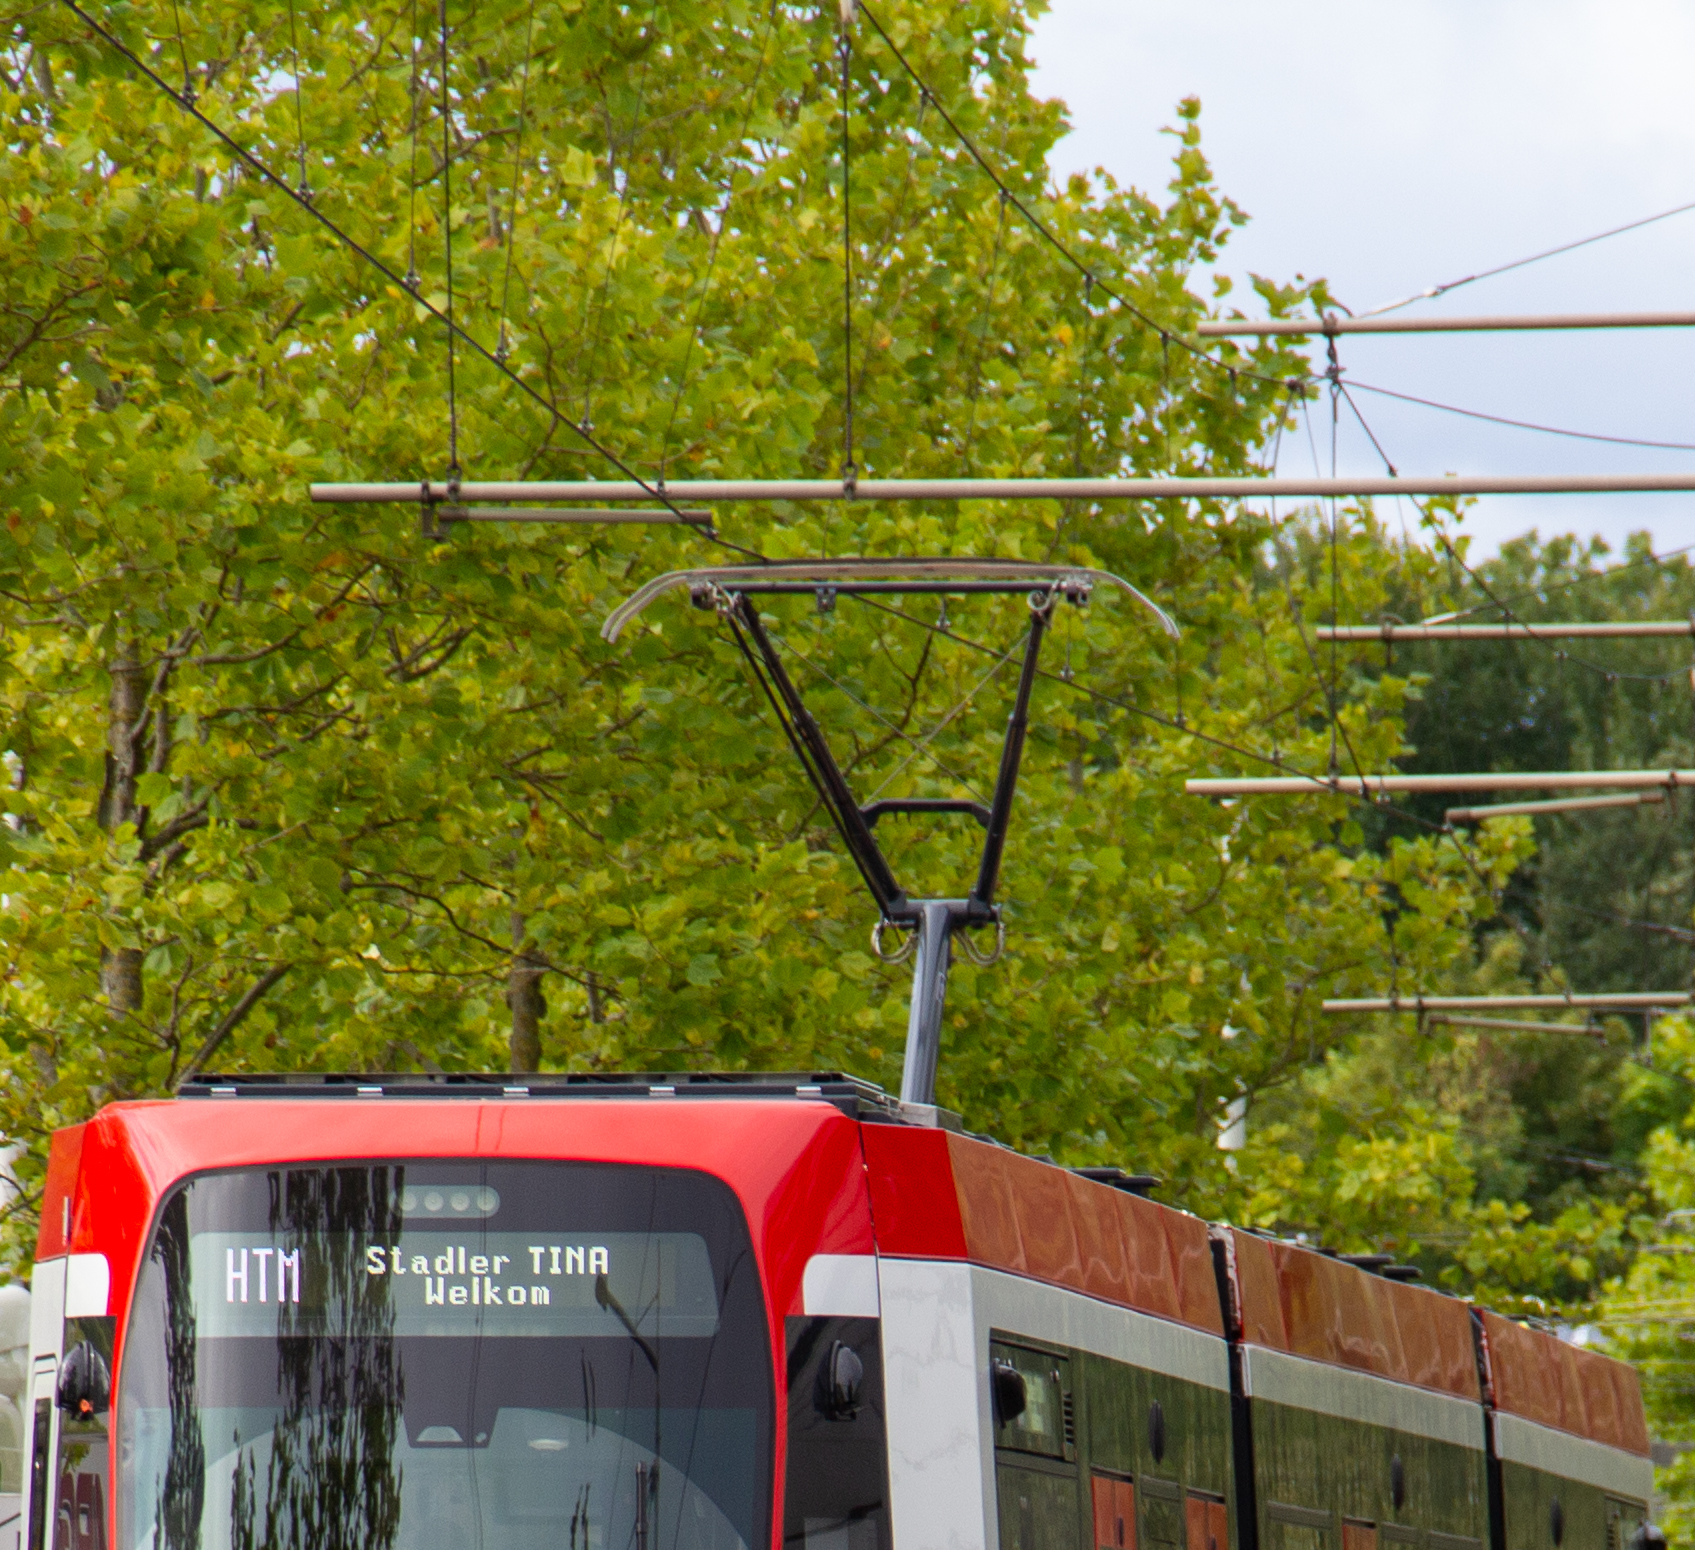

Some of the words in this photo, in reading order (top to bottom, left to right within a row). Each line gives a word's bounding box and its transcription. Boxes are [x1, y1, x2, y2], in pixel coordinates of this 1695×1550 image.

[367, 1246, 510, 1275] Stadler
[528, 1246, 609, 1275] TINA
[226, 1248, 299, 1303] HTM
[425, 1277, 550, 1305] Welkom
